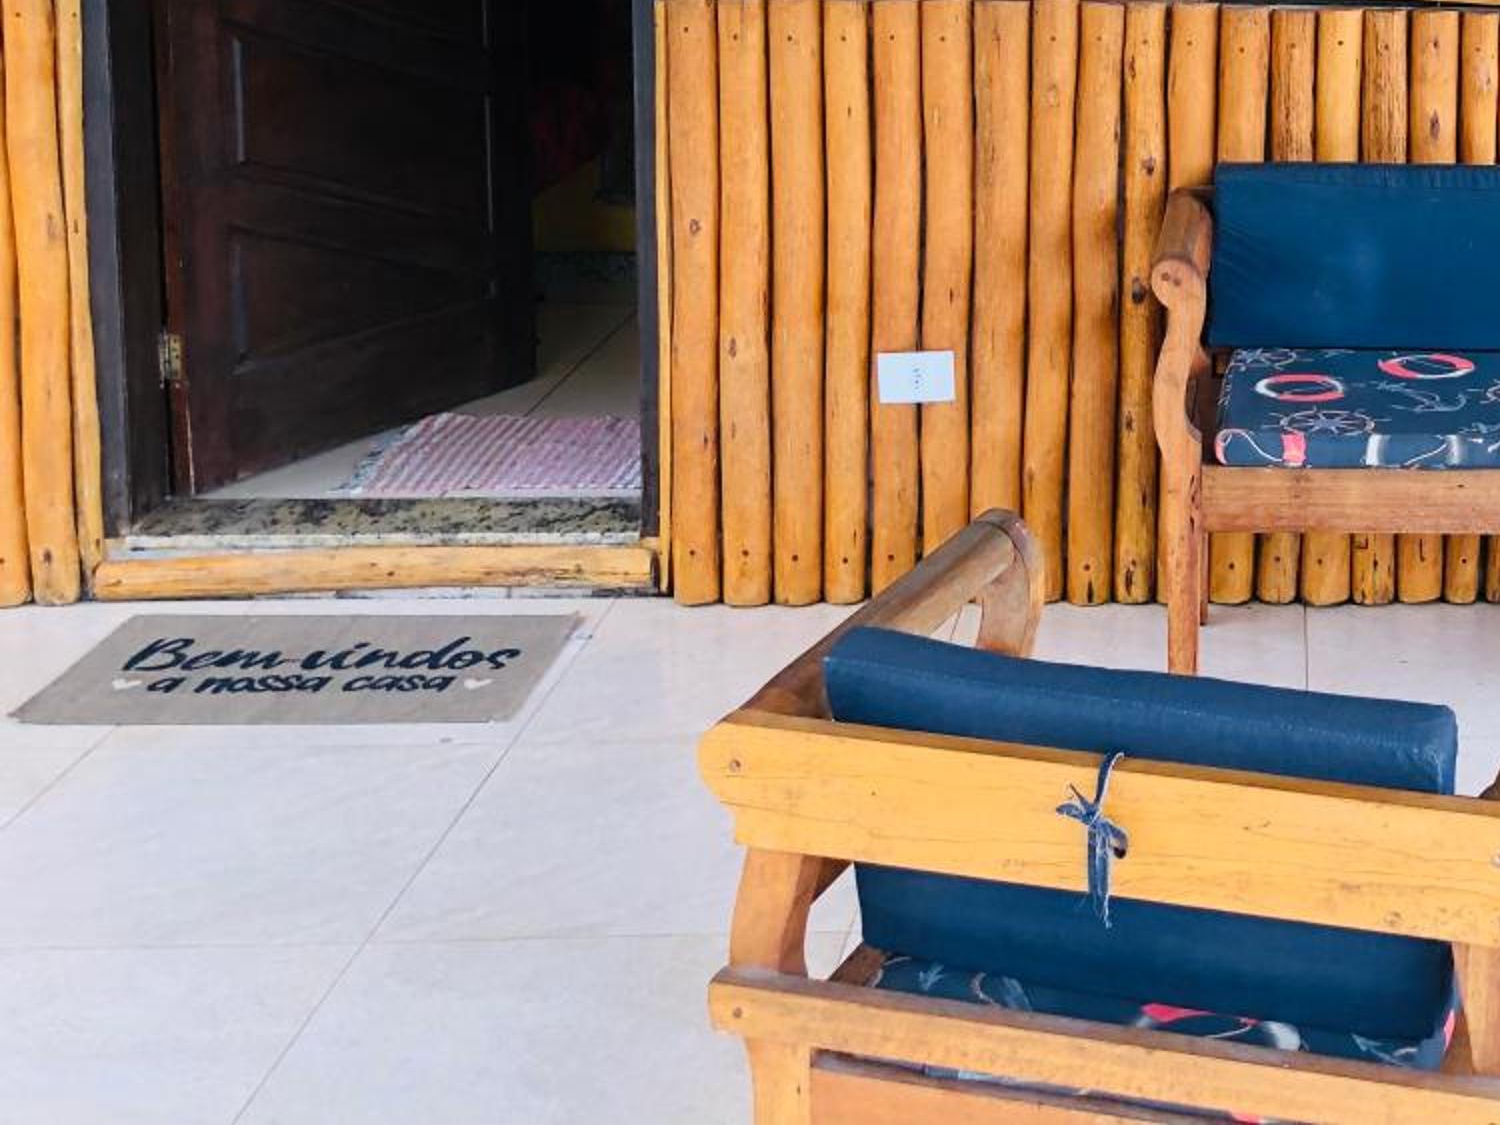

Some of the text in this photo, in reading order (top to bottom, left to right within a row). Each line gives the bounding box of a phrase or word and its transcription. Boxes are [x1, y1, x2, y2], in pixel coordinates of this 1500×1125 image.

[147, 675, 456, 694] a nossa casa
